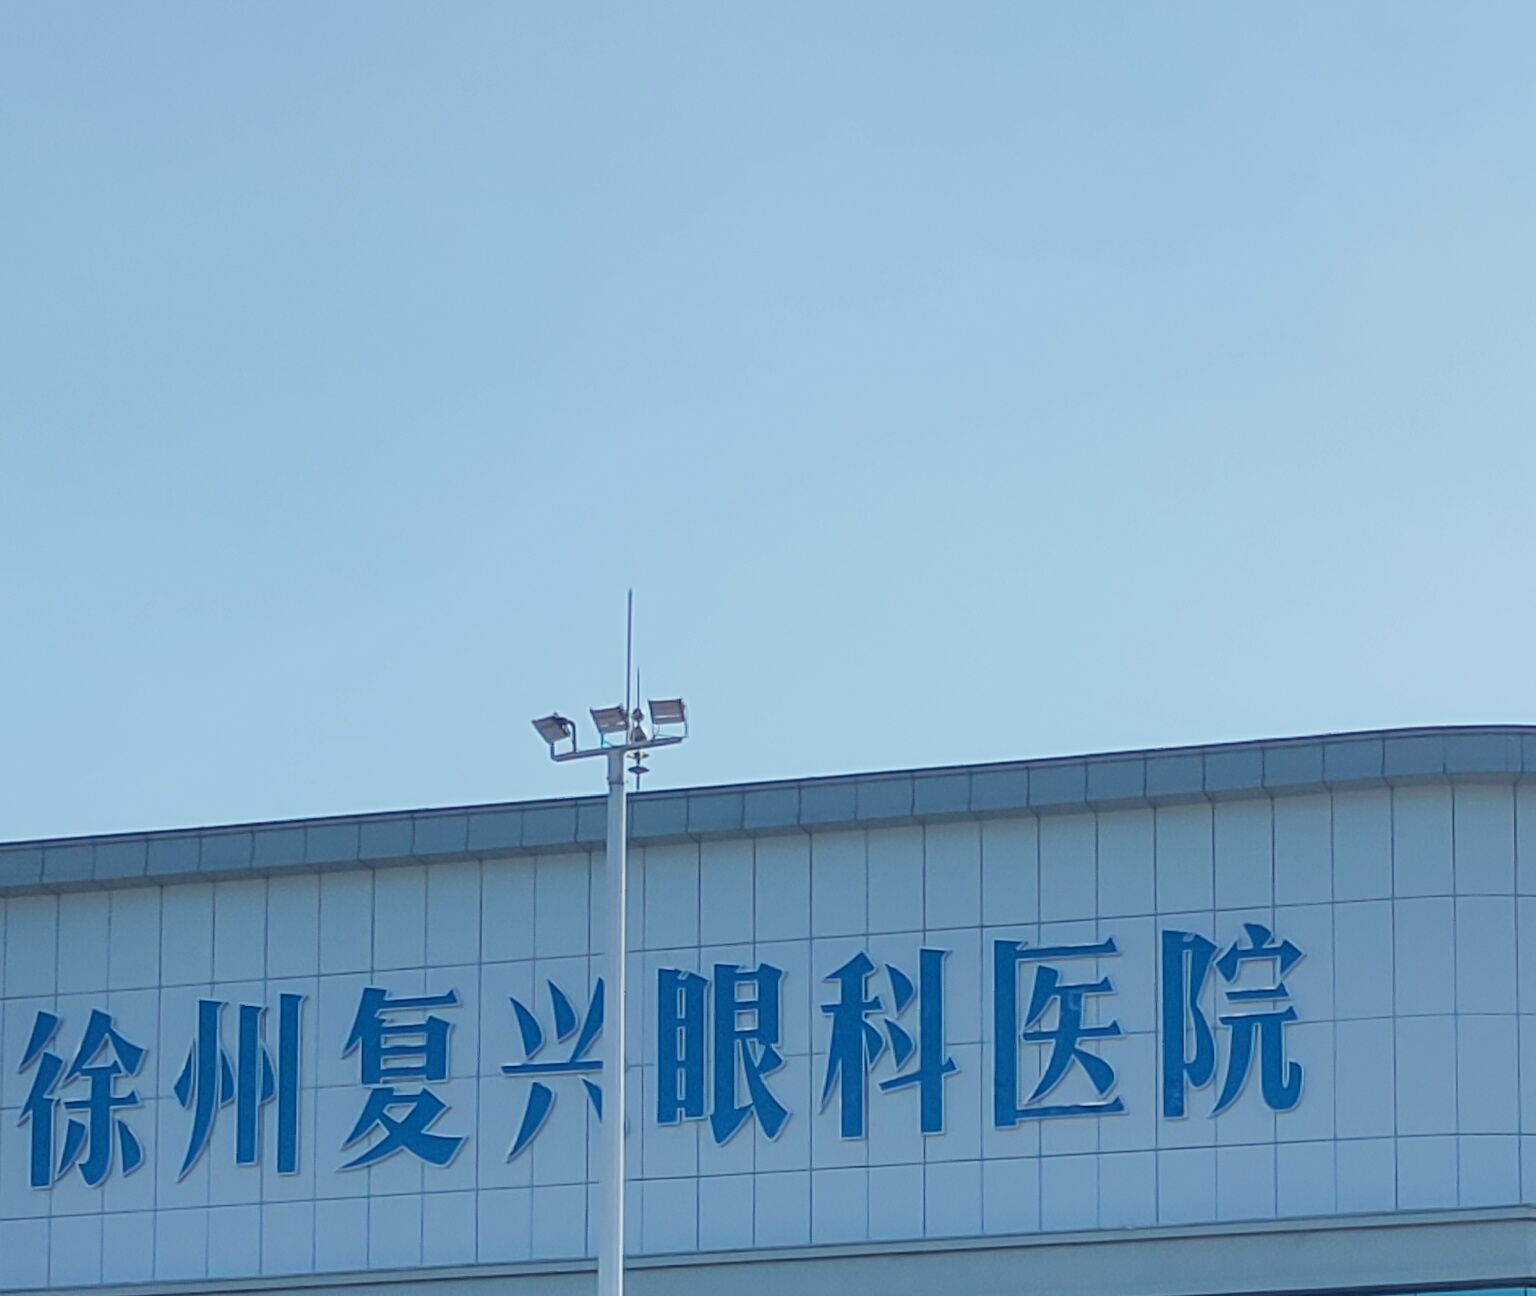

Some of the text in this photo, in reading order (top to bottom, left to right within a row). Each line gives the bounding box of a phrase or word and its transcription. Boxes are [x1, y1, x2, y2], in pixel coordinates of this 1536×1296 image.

[17, 923, 1305, 1189] 徐州复兴眼科医院
